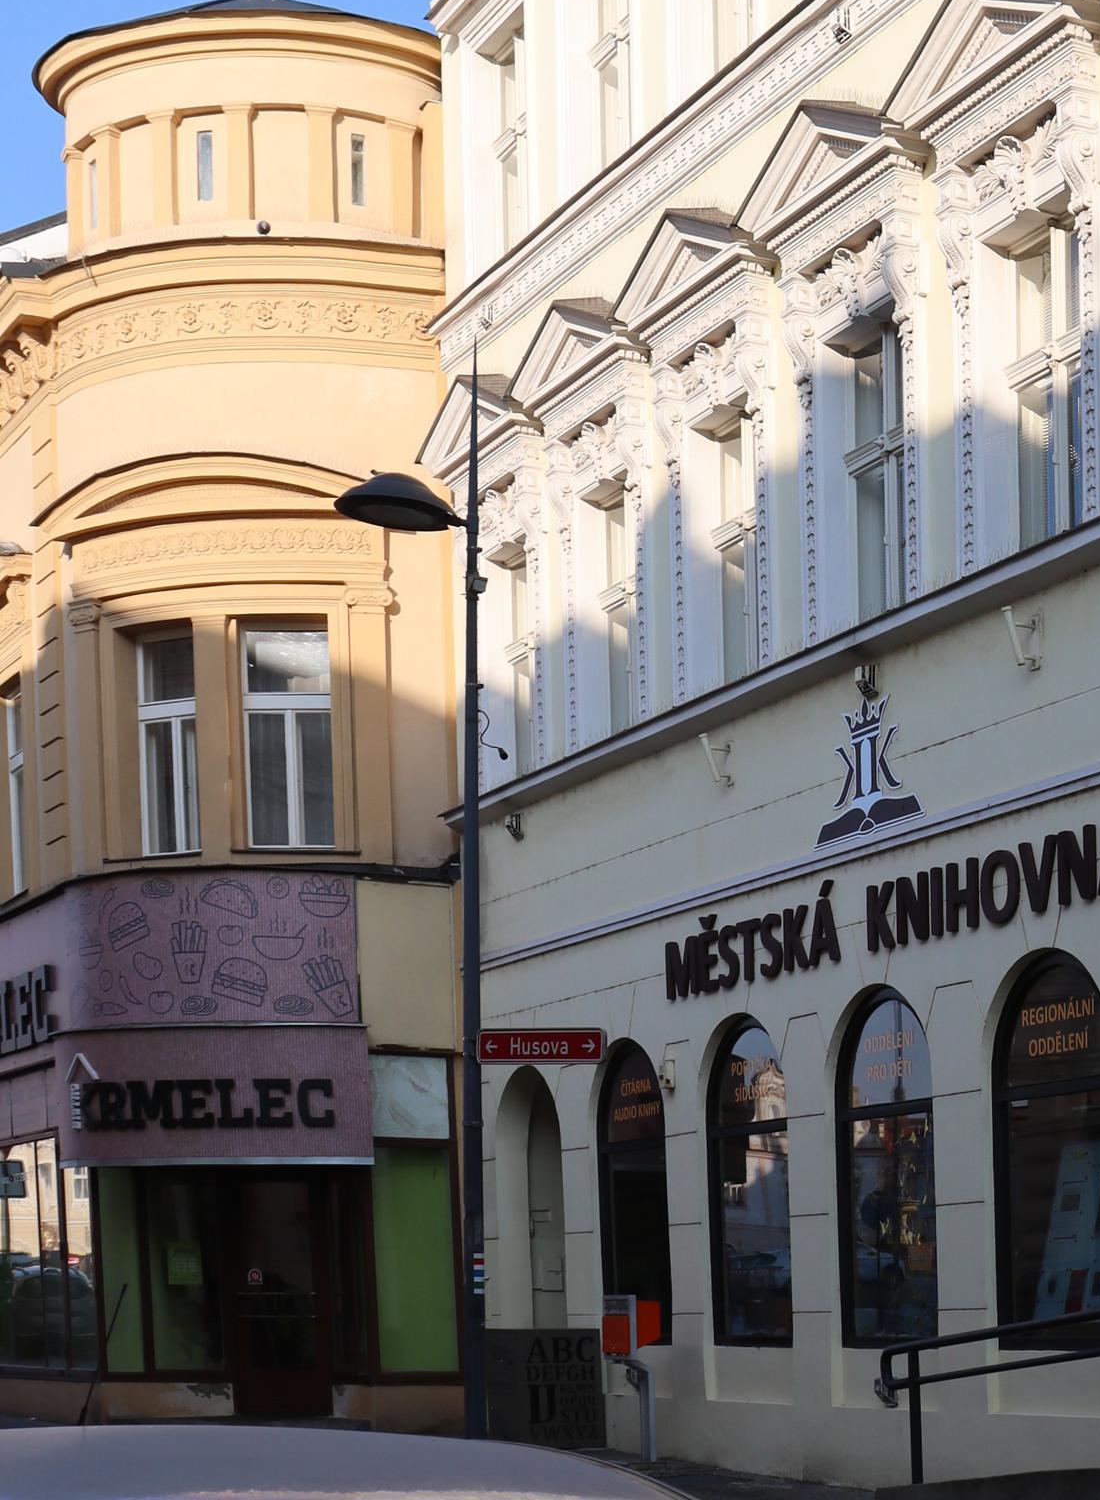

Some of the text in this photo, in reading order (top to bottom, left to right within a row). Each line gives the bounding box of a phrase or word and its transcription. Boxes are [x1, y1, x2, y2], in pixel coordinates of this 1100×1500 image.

[664, 879, 841, 1000] MĚSTSKÁ
[1021, 991, 1096, 1028] REGIONÁLNÍ
[509, 1036, 569, 1056] Husova
[1028, 1025, 1089, 1057] ODDĚLENÍ
[867, 1056, 913, 1082] PRO DĚTI
[614, 1100, 661, 1123] AUDIO KNIHY
[527, 1336, 595, 1364] ABC
[526, 1364, 595, 1382] DEFGH
[560, 1407, 597, 1423] STU
